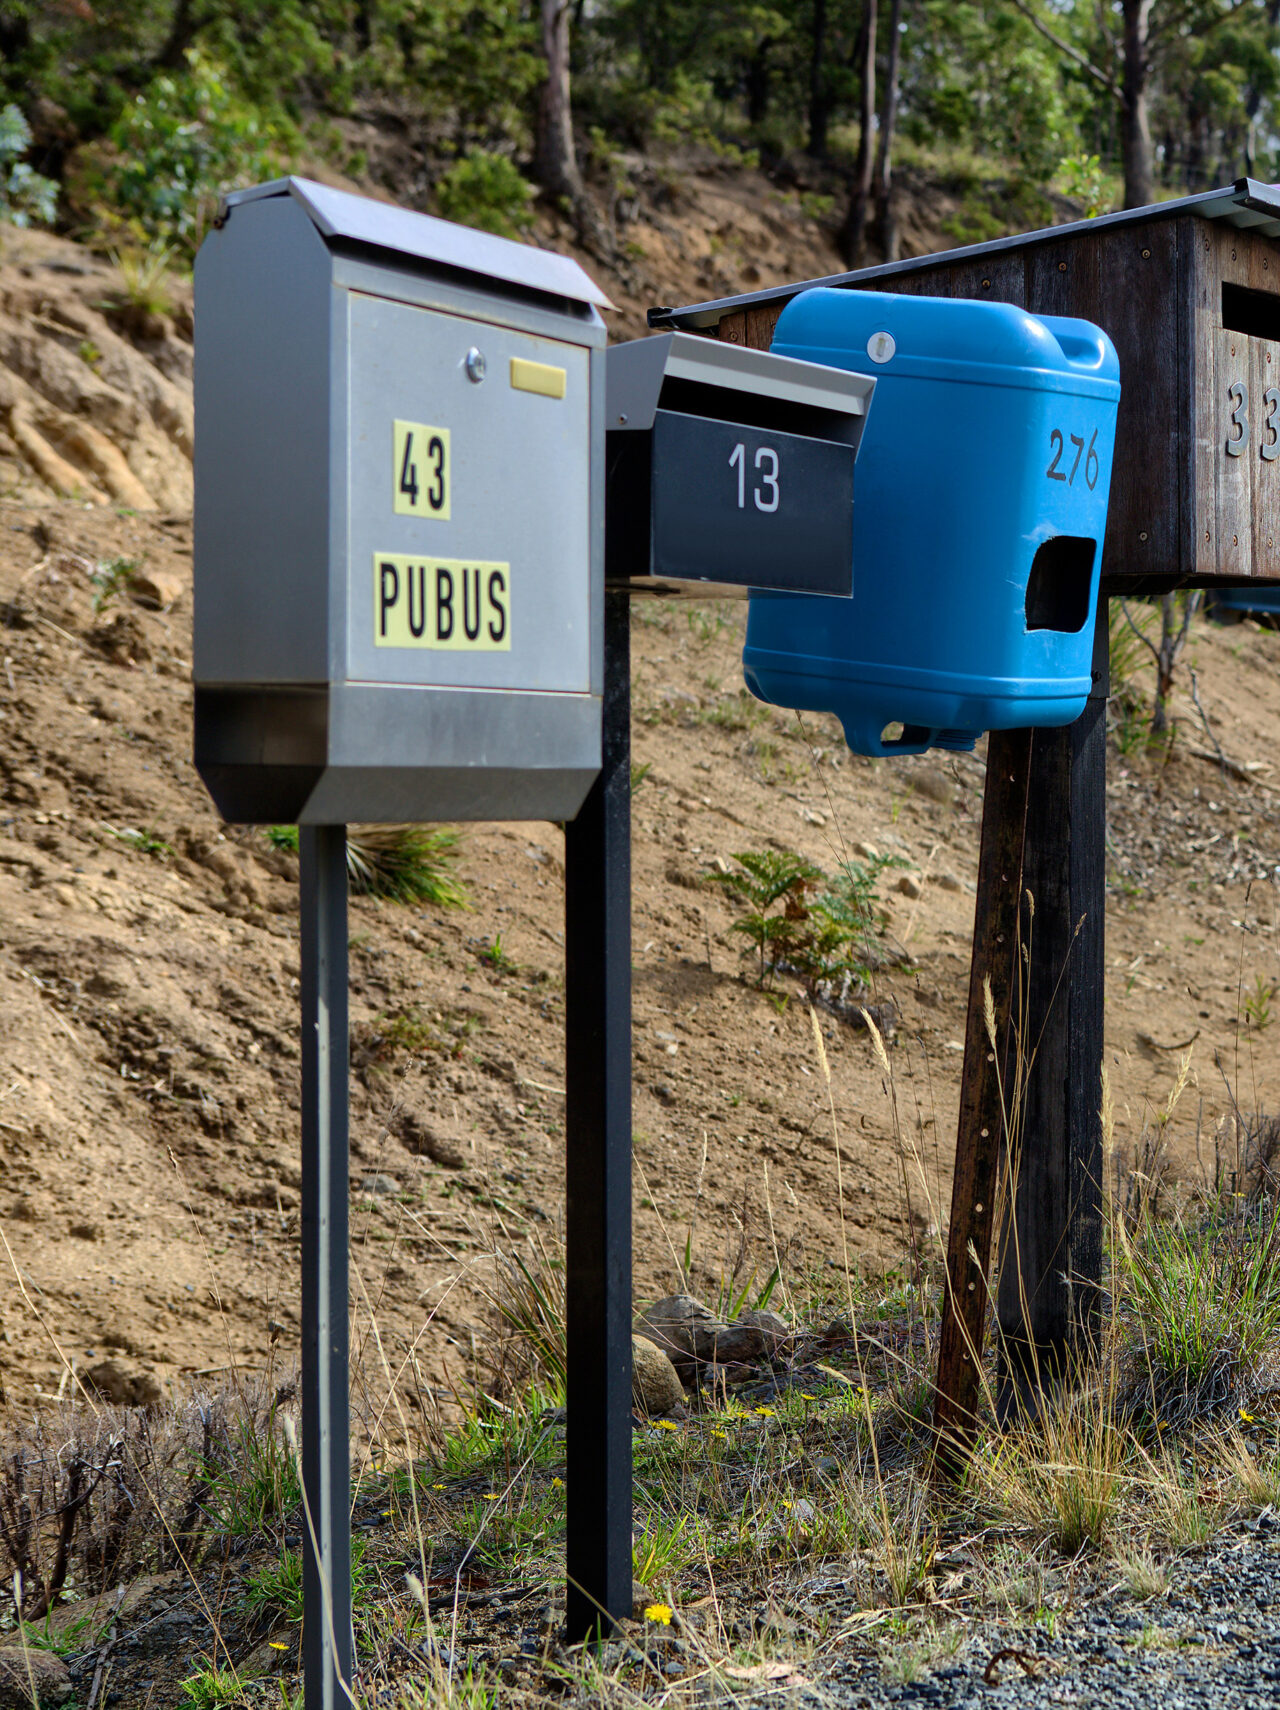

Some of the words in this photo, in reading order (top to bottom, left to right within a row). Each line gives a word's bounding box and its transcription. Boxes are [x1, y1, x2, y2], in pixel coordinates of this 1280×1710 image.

[400, 432, 445, 510] 43
[728, 443, 779, 512] 13
[1047, 428, 1098, 491] 276
[380, 562, 507, 642] PUBUS
